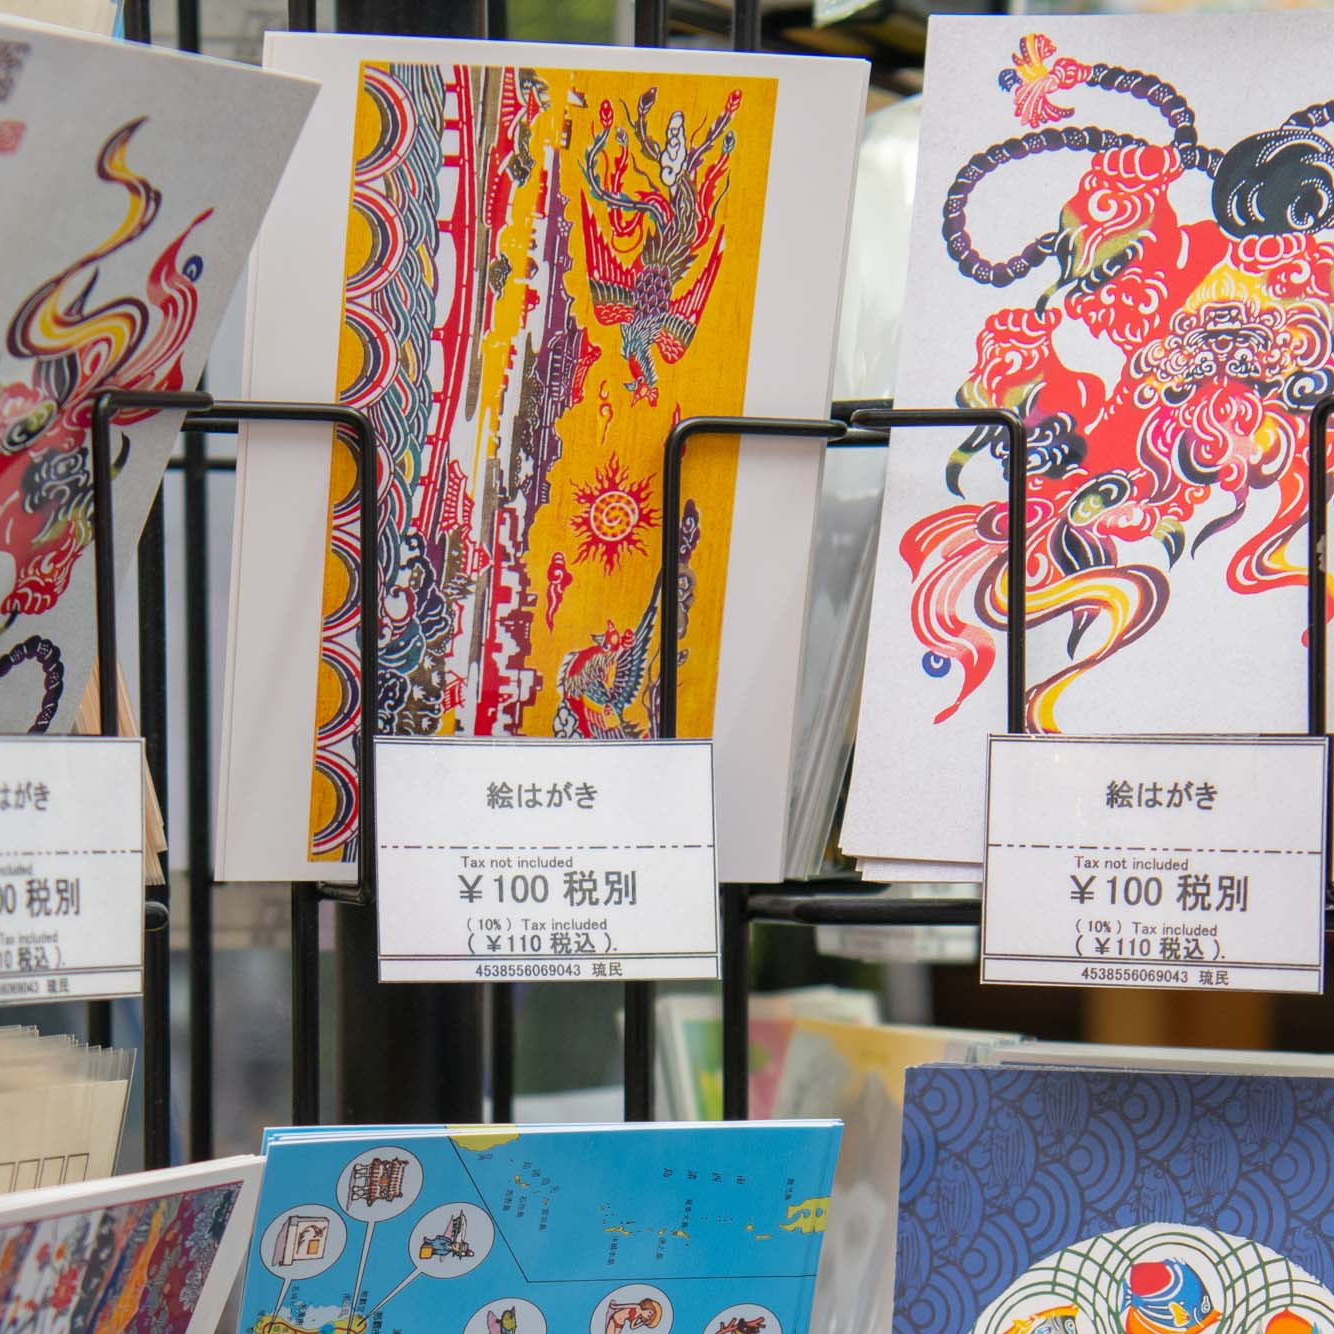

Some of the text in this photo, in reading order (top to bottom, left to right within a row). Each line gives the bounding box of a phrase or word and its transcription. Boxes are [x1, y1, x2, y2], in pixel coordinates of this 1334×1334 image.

[487, 781, 597, 809] 絵はがき
[1106, 780, 1218, 810] 絵はがき
[461, 856, 573, 868] Tax not included
[1075, 856, 1189, 871] Tax not included
[458, 870, 637, 906] ¥100 税別
[1070, 873, 1249, 912] ¥100 税別
[522, 919, 546, 930] Tax
[551, 918, 608, 930] included
[1132, 922, 1157, 935] Tax
[1162, 923, 1218, 937] included
[475, 962, 623, 977] 4538556069043 琉民
[1081, 969, 1229, 986] 4538556069043 琉民
